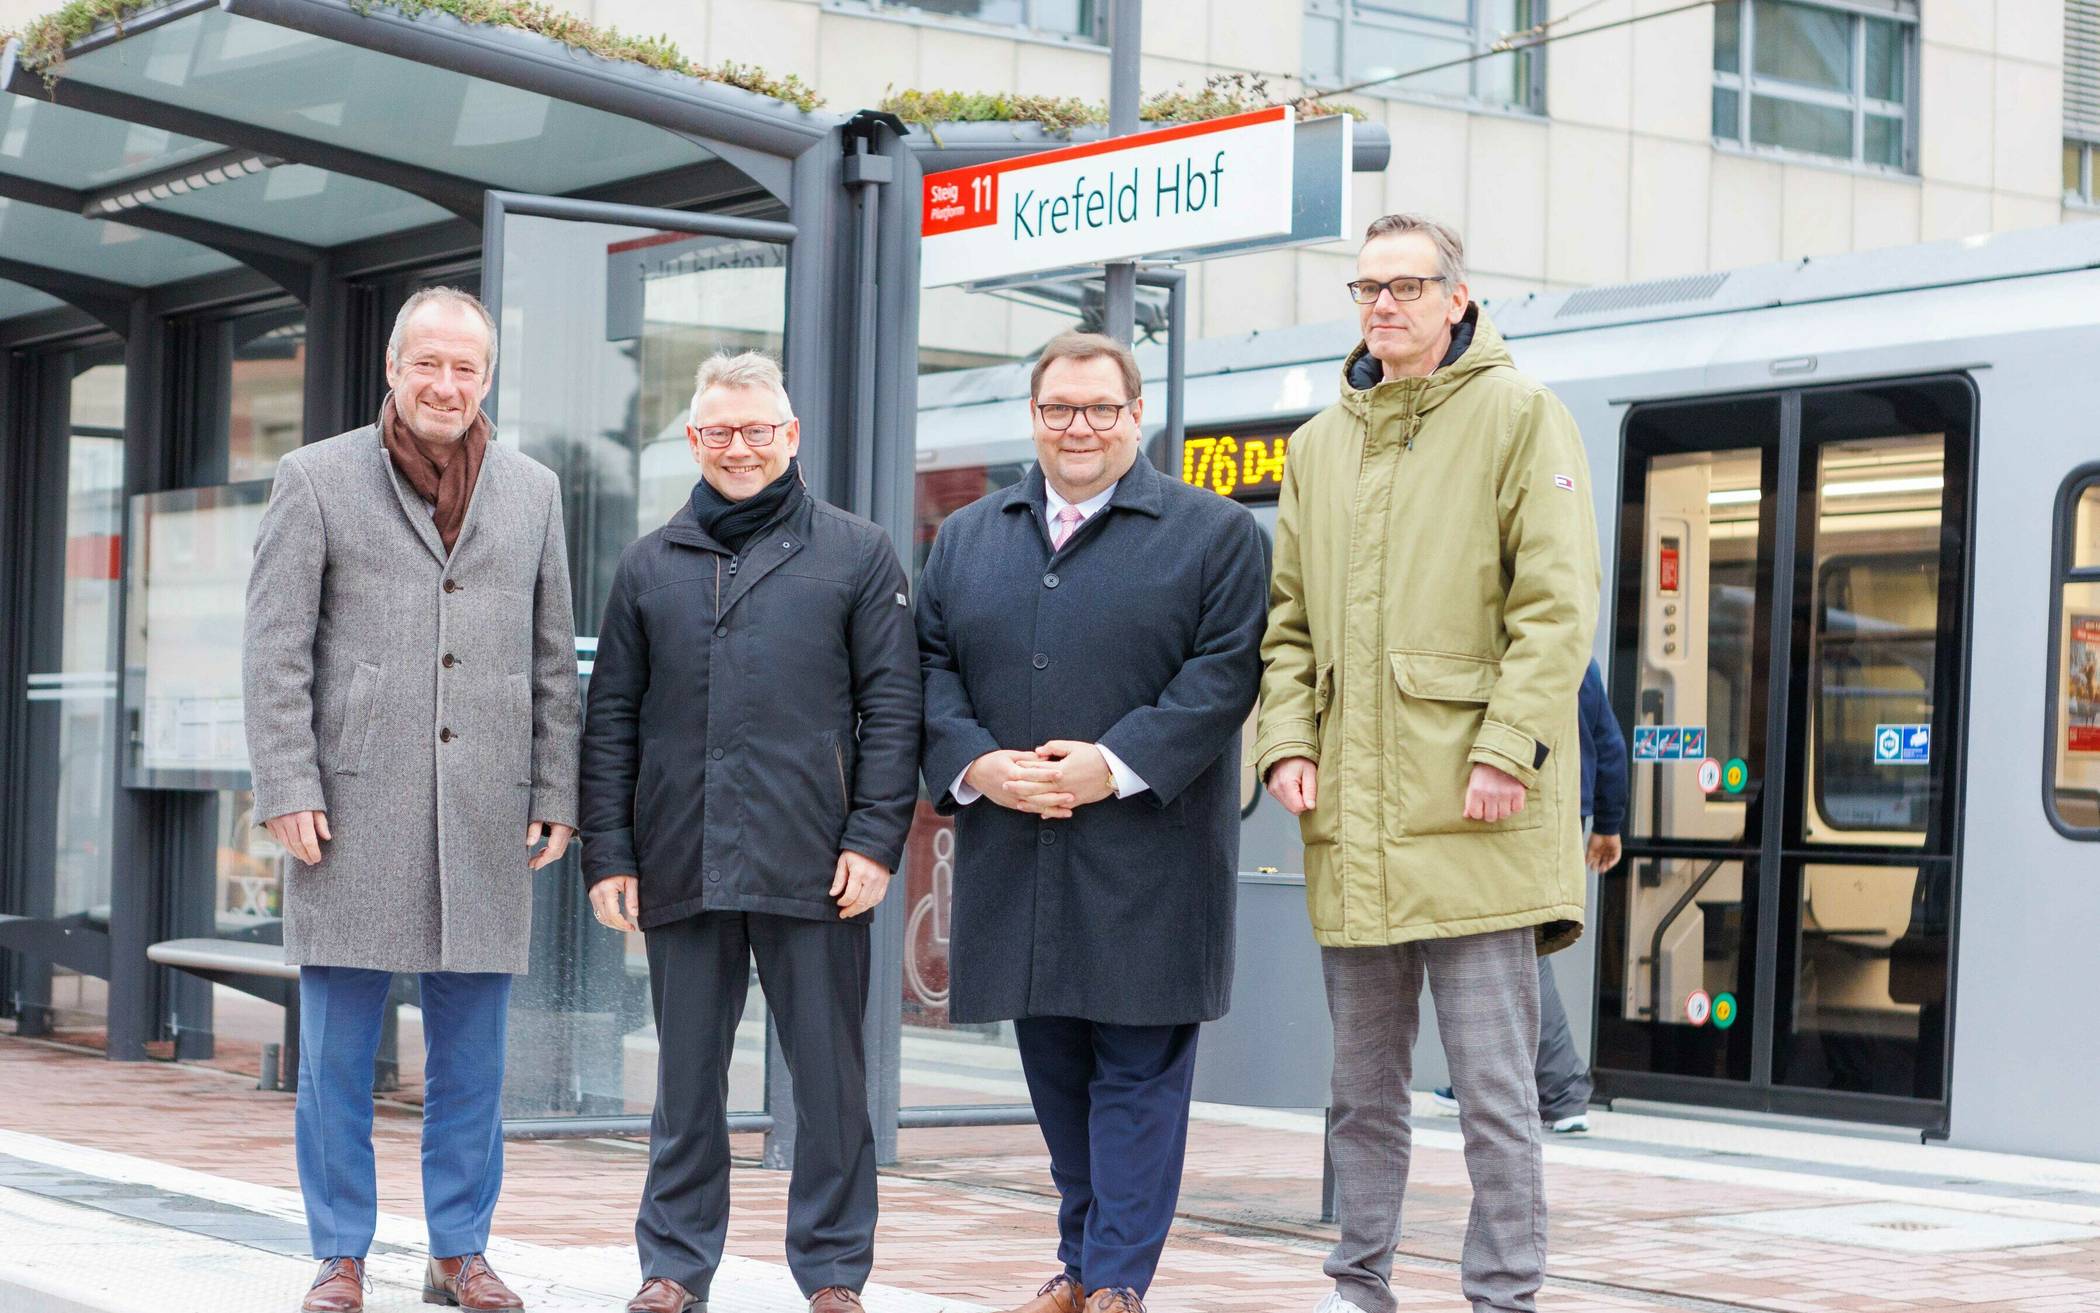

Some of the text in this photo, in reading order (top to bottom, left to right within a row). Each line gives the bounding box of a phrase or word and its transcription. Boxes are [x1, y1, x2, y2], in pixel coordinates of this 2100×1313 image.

[930, 182, 959, 204] Steig
[970, 175, 992, 213] 11
[1014, 150, 1225, 241] Krefeld Hbf
[930, 204, 966, 222] Platform
